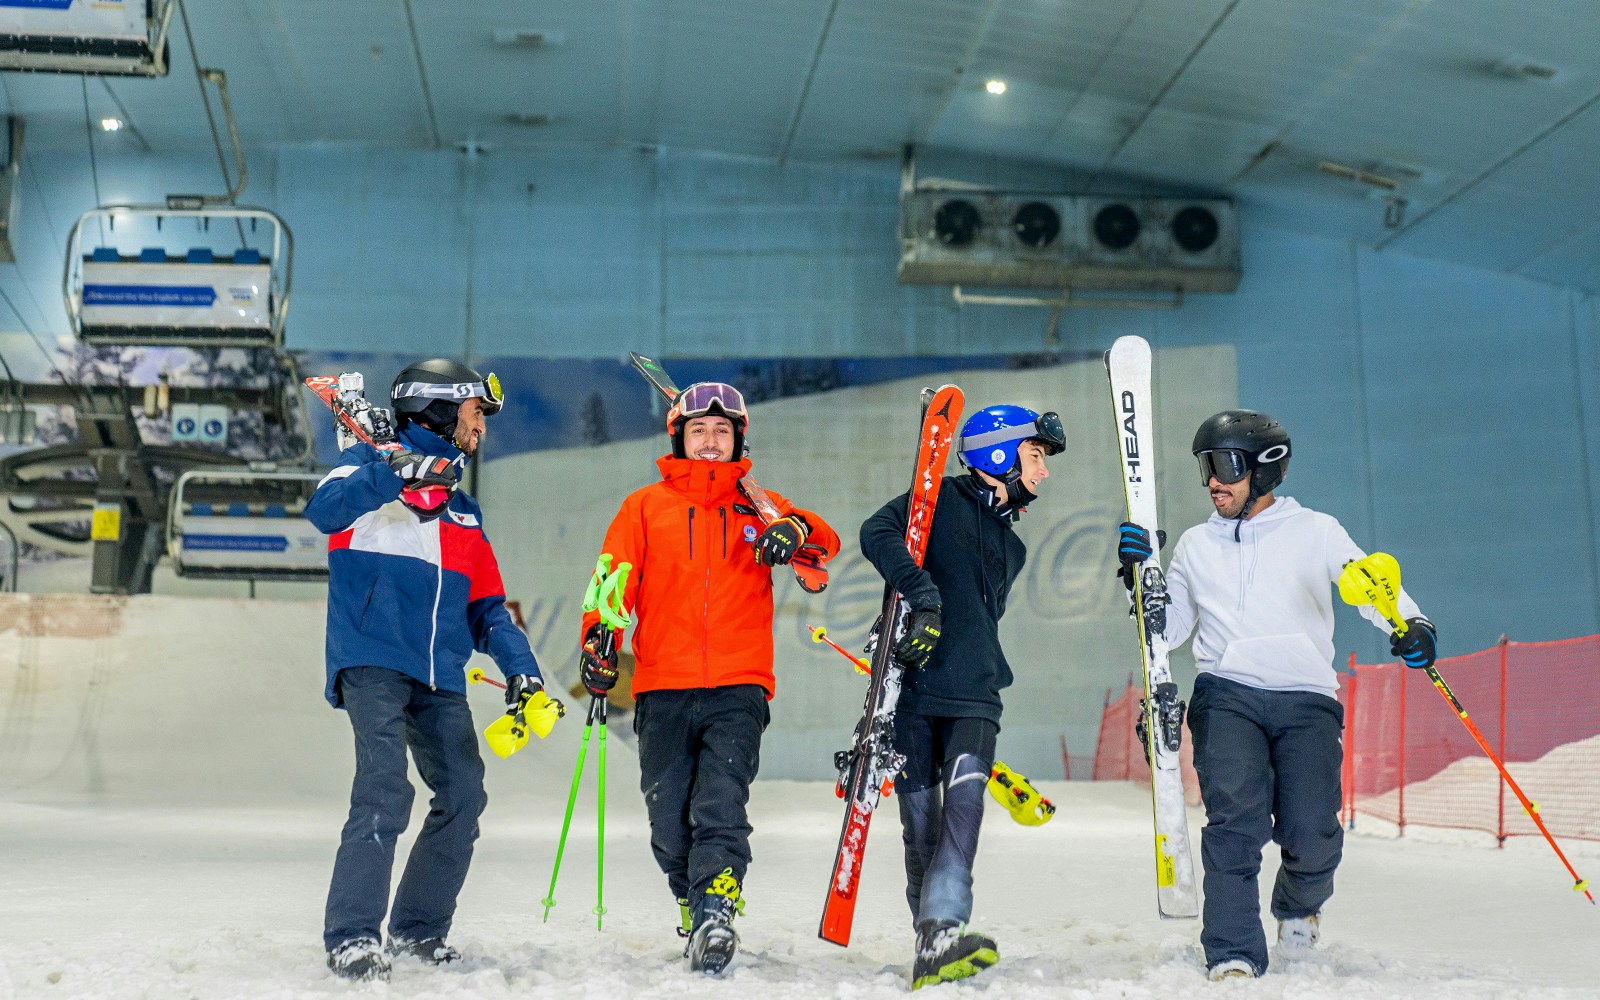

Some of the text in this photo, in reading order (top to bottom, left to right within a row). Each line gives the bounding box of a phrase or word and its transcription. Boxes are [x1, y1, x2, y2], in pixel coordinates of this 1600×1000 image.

[1122, 391, 1141, 482] HEAD
[772, 531, 791, 545] LEKI
[1380, 577, 1395, 601] LEKI
